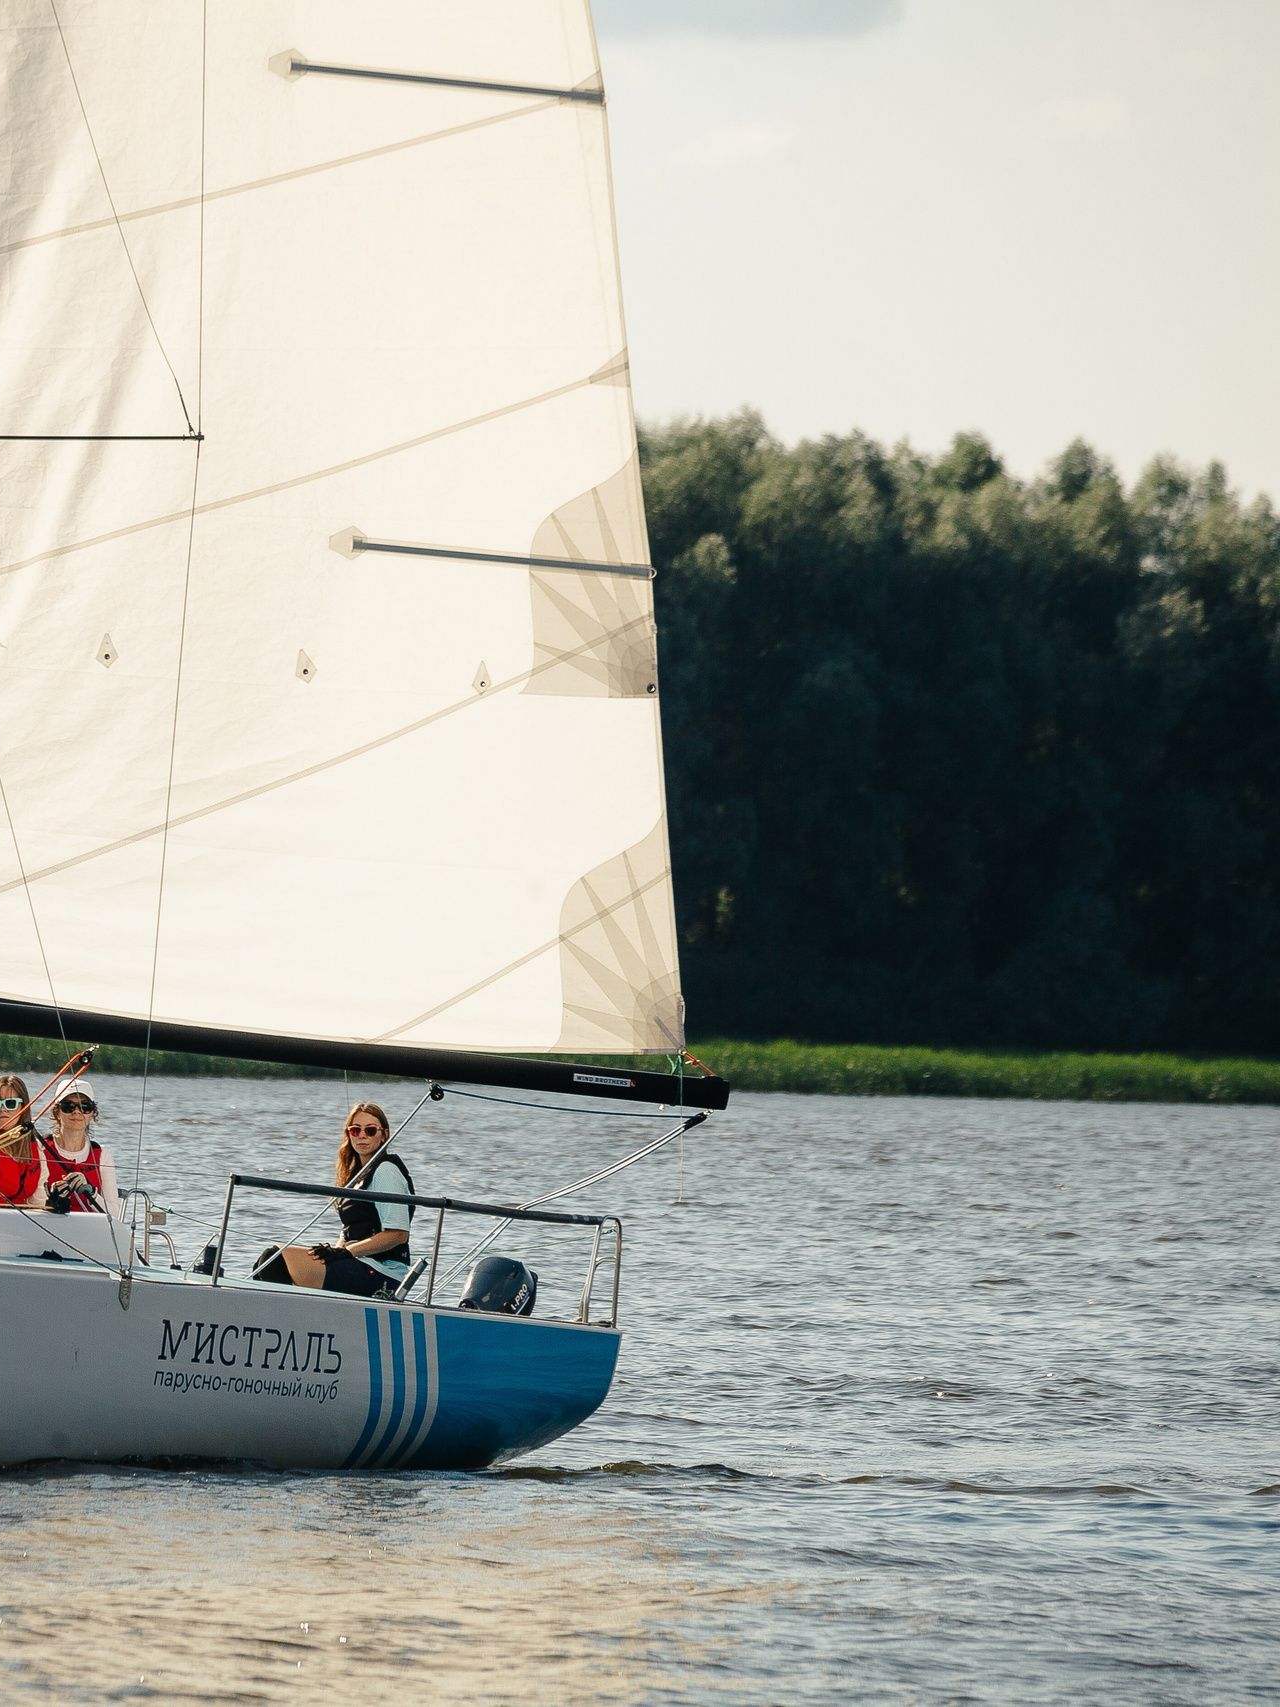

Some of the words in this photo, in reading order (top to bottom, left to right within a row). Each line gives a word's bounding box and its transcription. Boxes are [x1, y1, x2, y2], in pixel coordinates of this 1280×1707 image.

[576, 1075, 594, 1083] WIND
[595, 1077, 628, 1086] BROTHERS
[158, 1319, 342, 1375] МИСТРАЛЬ
[153, 1370, 303, 1398] парусно-гоночный
[305, 1380, 340, 1404] клуб
